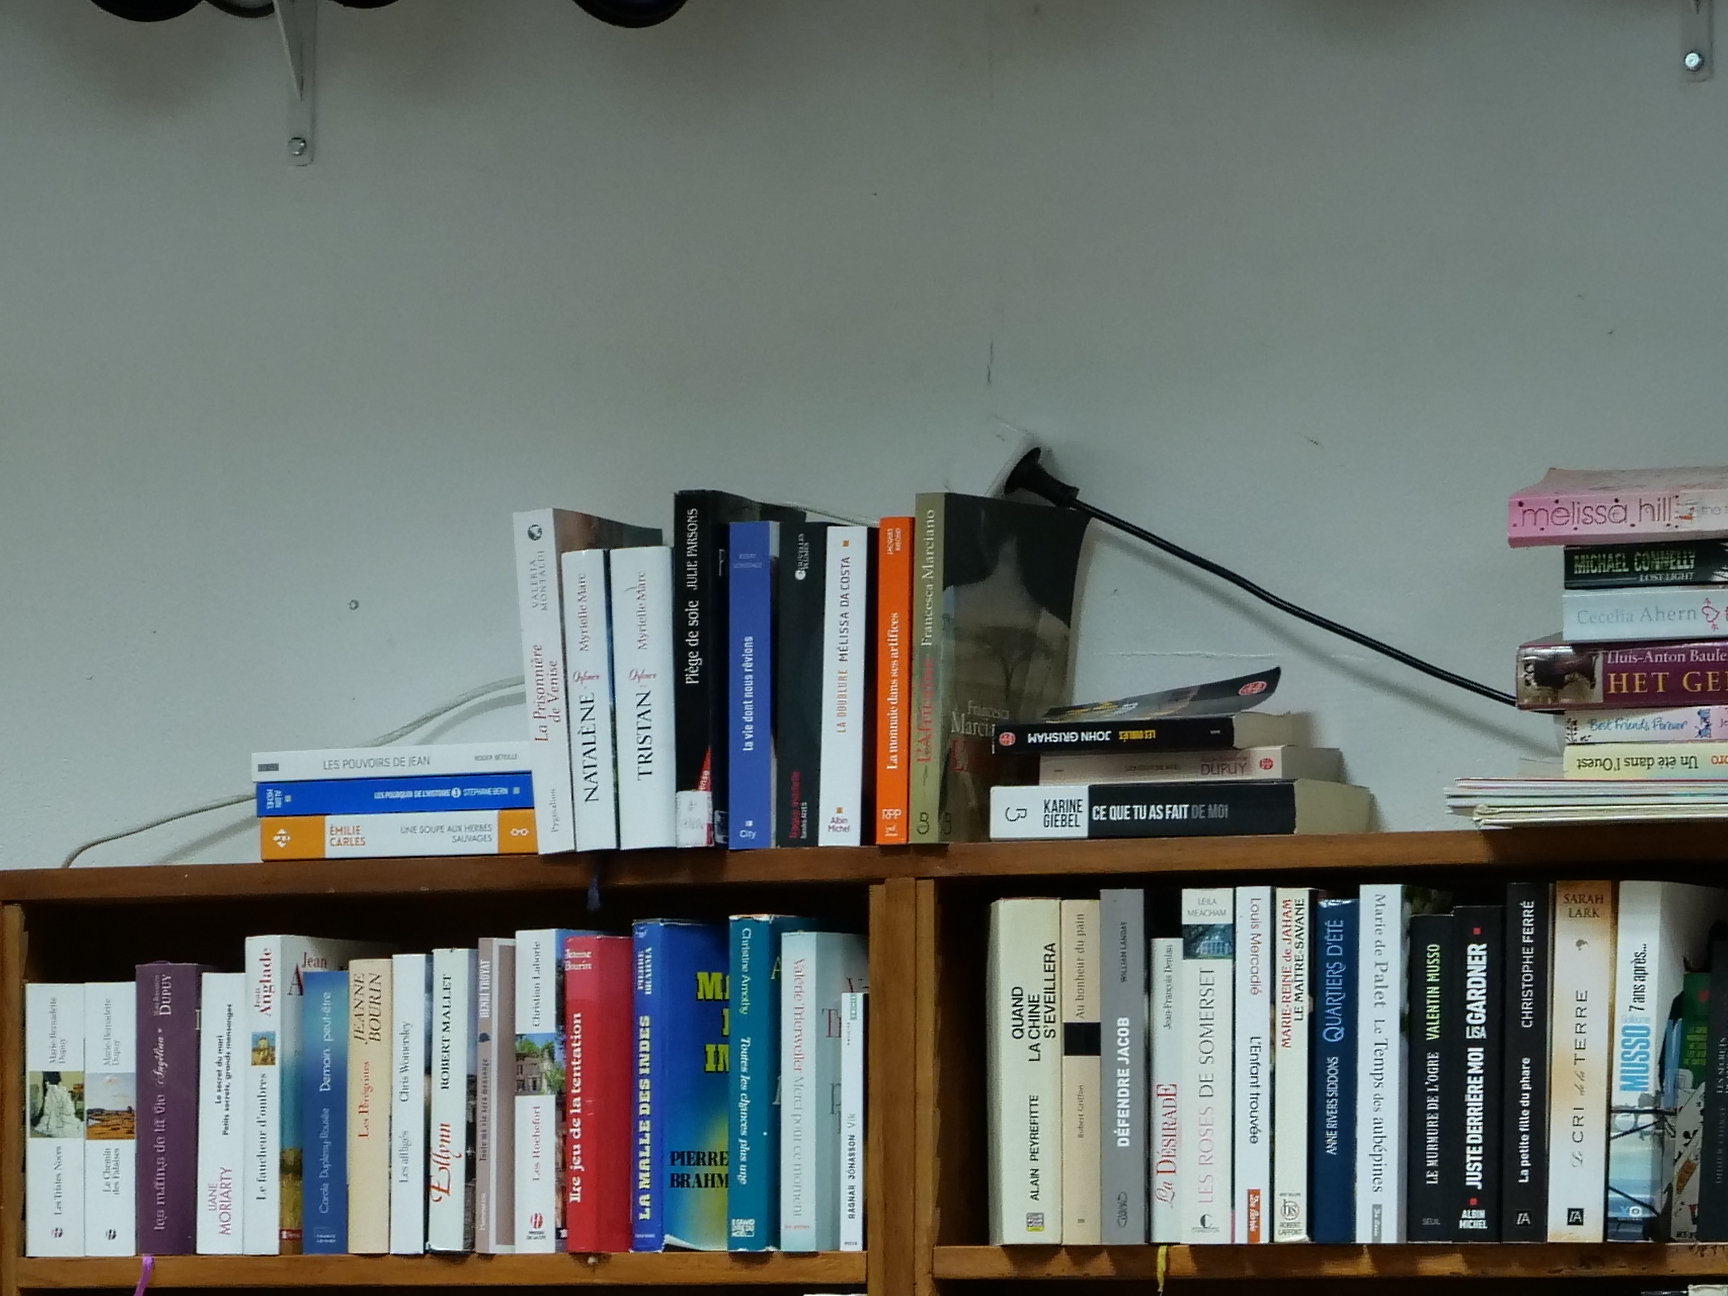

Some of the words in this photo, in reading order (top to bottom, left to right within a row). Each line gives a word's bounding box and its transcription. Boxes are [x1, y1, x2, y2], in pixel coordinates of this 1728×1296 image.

[686, 509, 698, 558] PARSONS
[921, 509, 936, 579] Marciano
[686, 561, 698, 590] JULIE
[1574, 551, 1630, 575] MICHAEL
[1634, 549, 1696, 573] CONNELLY
[686, 600, 699, 626] soie
[920, 582, 935, 647] Francesca
[686, 631, 699, 647] de
[530, 644, 546, 721] Prisonnière
[546, 660, 559, 705] Venise
[685, 649, 702, 685] Piège
[1606, 671, 1673, 695] HET
[534, 723, 549, 742] La
[548, 707, 561, 723] de
[636, 690, 653, 781] TRISTAN
[1027, 731, 1078, 743] GRISHAM
[1080, 731, 1112, 742] JOHN
[577, 694, 600, 802] NATALÈNE
[1043, 813, 1080, 828] GIEBEL
[1044, 799, 1083, 813] KARINE
[1093, 805, 1106, 821] CE
[1109, 804, 1130, 821] QUE
[1132, 804, 1145, 820] TU
[1149, 804, 1163, 819] AS
[1165, 803, 1189, 819] FAIT
[330, 825, 361, 836] ÉMILIE
[330, 837, 366, 847] CARLES
[1519, 901, 1535, 944] FERRÉ
[1044, 942, 1057, 1039] S'EVEILLERA
[1468, 944, 1488, 1024] GARDNER
[1521, 947, 1535, 1028] CHRISTOPHE
[1011, 986, 1025, 1039] QUAND
[1028, 994, 1041, 1040] CHINE
[1199, 967, 1215, 1065] SOMERSET
[639, 1015, 651, 1075] INDES
[1028, 1043, 1041, 1062] LA
[1116, 1017, 1130, 1065] JACOB
[1467, 1047, 1484, 1074] MOI
[1619, 1025, 1652, 1092] MUSSO
[639, 1077, 651, 1116] DES
[1199, 1073, 1215, 1098] DE
[1029, 1094, 1039, 1161] PEYREFITTE
[1114, 1069, 1130, 1147] DÉFENDRE
[1463, 1076, 1484, 1144] DERRIÈRE
[638, 1119, 651, 1189] MALLE
[1199, 1106, 1215, 1165] ROSES
[1029, 1168, 1039, 1201] ALAIN
[1199, 1174, 1215, 1204] LES
[1466, 1145, 1484, 1190] JUSTE
[218, 1167, 232, 1235] MORIARTY
[639, 1192, 651, 1220] LA
